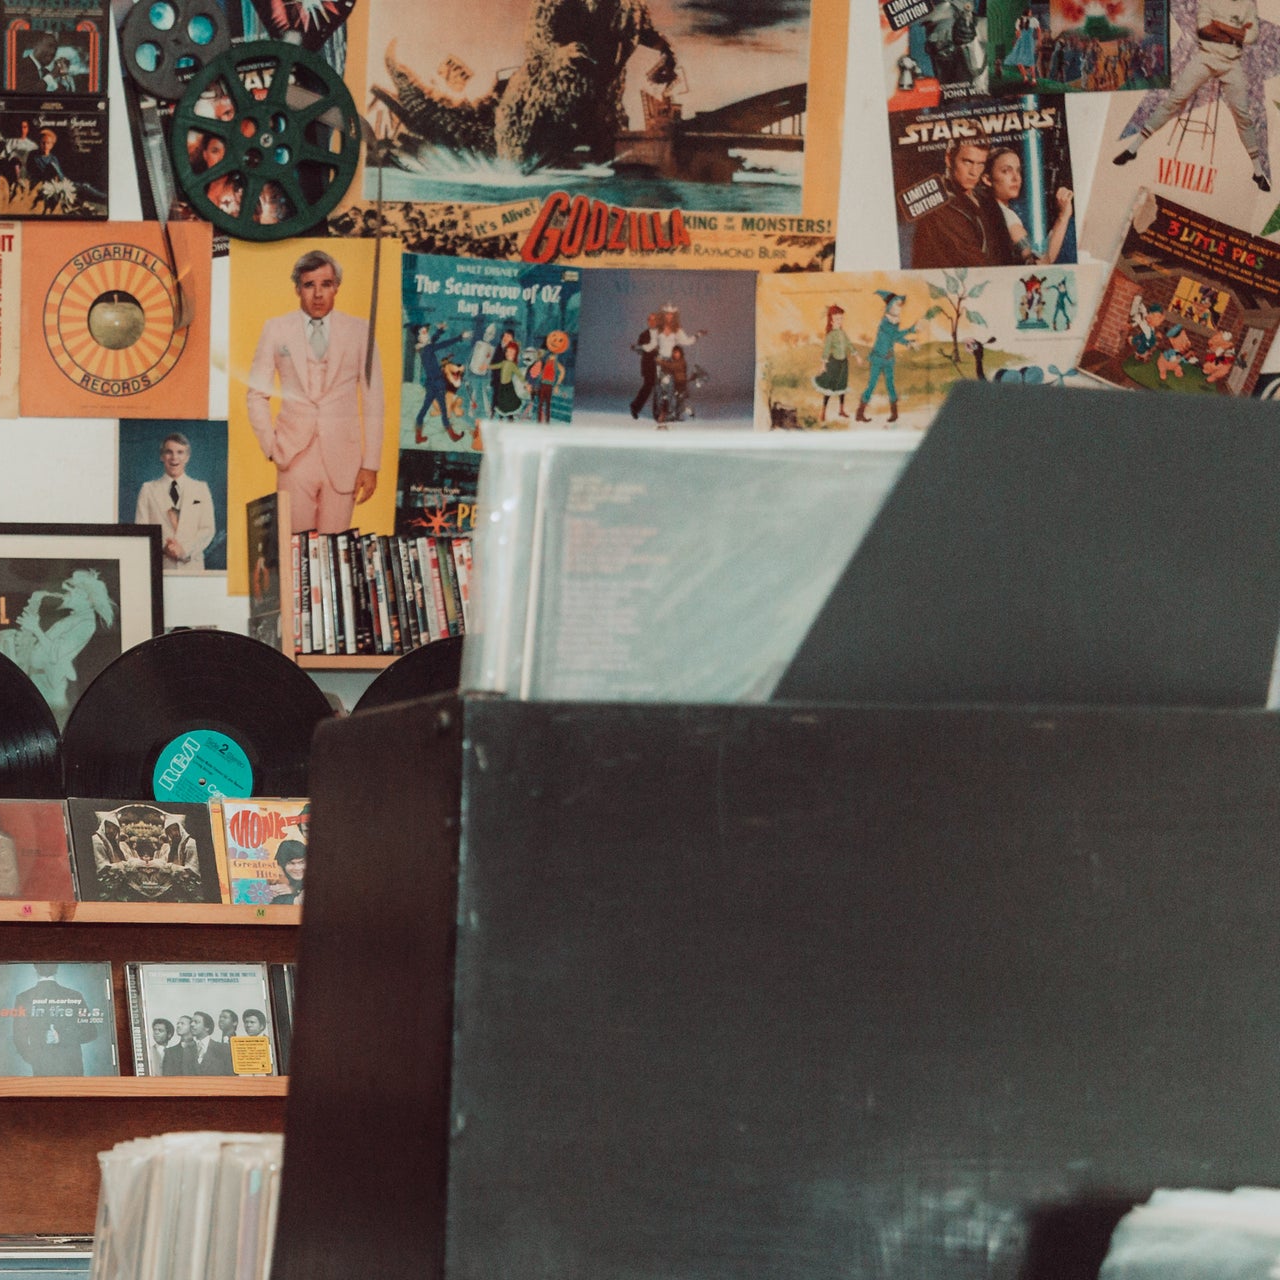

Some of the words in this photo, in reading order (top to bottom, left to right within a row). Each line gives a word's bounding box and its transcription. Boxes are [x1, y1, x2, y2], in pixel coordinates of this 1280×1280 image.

[893, 2, 930, 27] EDITION
[943, 89, 967, 100] JOHN
[898, 120, 977, 145] STAR
[978, 107, 1056, 135] WARS
[1156, 157, 1218, 195] NEVILLE
[902, 178, 938, 205] LIMITED
[908, 191, 944, 218] EDITION
[474, 217, 498, 237] It's
[500, 201, 538, 229] Alive!
[520, 191, 691, 263] GODZILLA
[683, 214, 718, 231] KING
[741, 216, 832, 234] MONSTERS!
[1167, 219, 1181, 236] 3
[73, 243, 163, 275] SUGARHILL
[1179, 227, 1228, 256] LITTLE
[1231, 247, 1265, 270] PIGS
[414, 273, 440, 295] The
[445, 277, 519, 300] Scarecrow
[522, 282, 538, 303] of
[541, 283, 561, 303] OZ
[80, 373, 154, 396] RECORDS
[219, 743, 229, 755] 2
[158, 736, 201, 792] RCA
[232, 860, 278, 869] Greatest
[255, 870, 280, 879] Hits
[31, 1005, 47, 1018] in
[49, 1005, 75, 1018] the
[77, 1006, 105, 1018] u.s.
[32, 998, 48, 1006] paul
